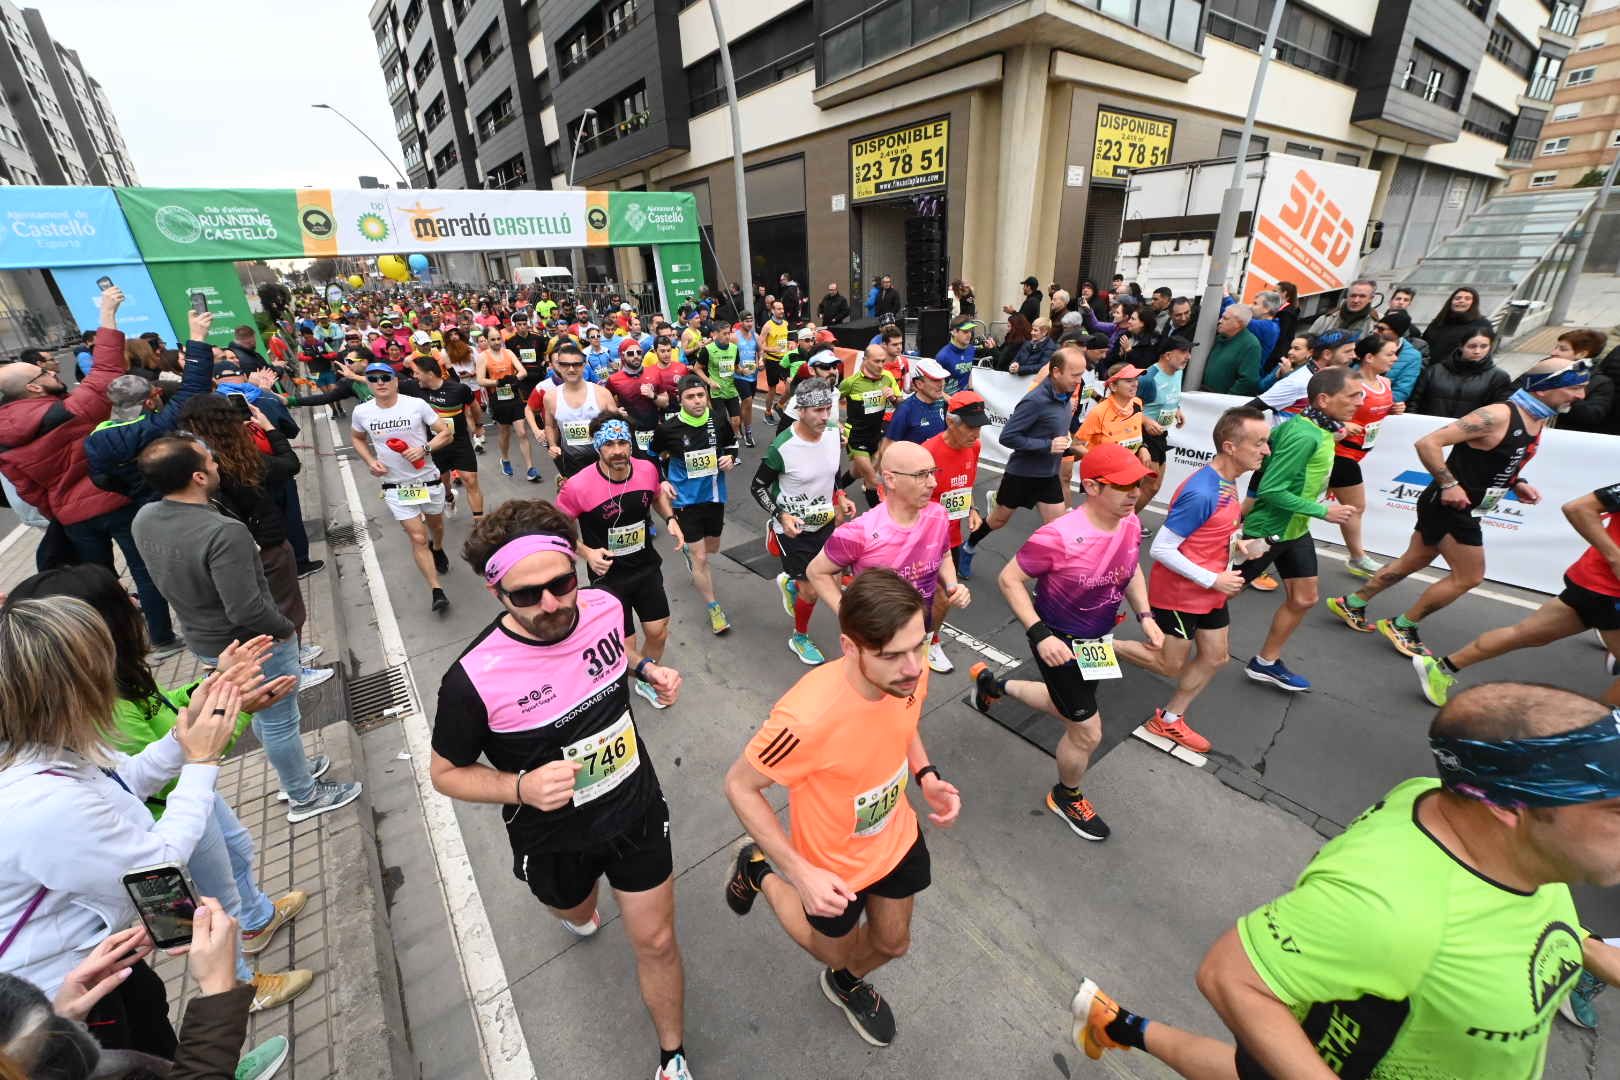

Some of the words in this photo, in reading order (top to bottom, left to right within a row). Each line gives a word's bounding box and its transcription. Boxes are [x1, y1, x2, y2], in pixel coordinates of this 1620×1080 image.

[1100, 113, 1169, 138] DISPONIBLE
[855, 122, 943, 157] DISPONIBLE
[862, 160, 883, 182] 23
[889, 153, 913, 177] 78
[921, 146, 944, 171] 51
[1102, 138, 1122, 162] 23
[1128, 142, 1146, 165] 78
[1150, 146, 1167, 167] 51
[371, 202, 384, 211] bp
[199, 213, 272, 227] RUNNING
[415, 212, 492, 239] marató
[493, 212, 572, 236] CASTELLÓ
[568, 426, 587, 438] 969
[692, 455, 711, 468] 833
[402, 489, 421, 497] 287
[946, 495, 965, 509] 863
[616, 530, 639, 545] 470
[582, 627, 625, 677] 30K
[1081, 646, 1107, 662] 903
[554, 682, 621, 729] CRONOMETRA
[583, 736, 626, 776] 746
[869, 784, 899, 821] 719
